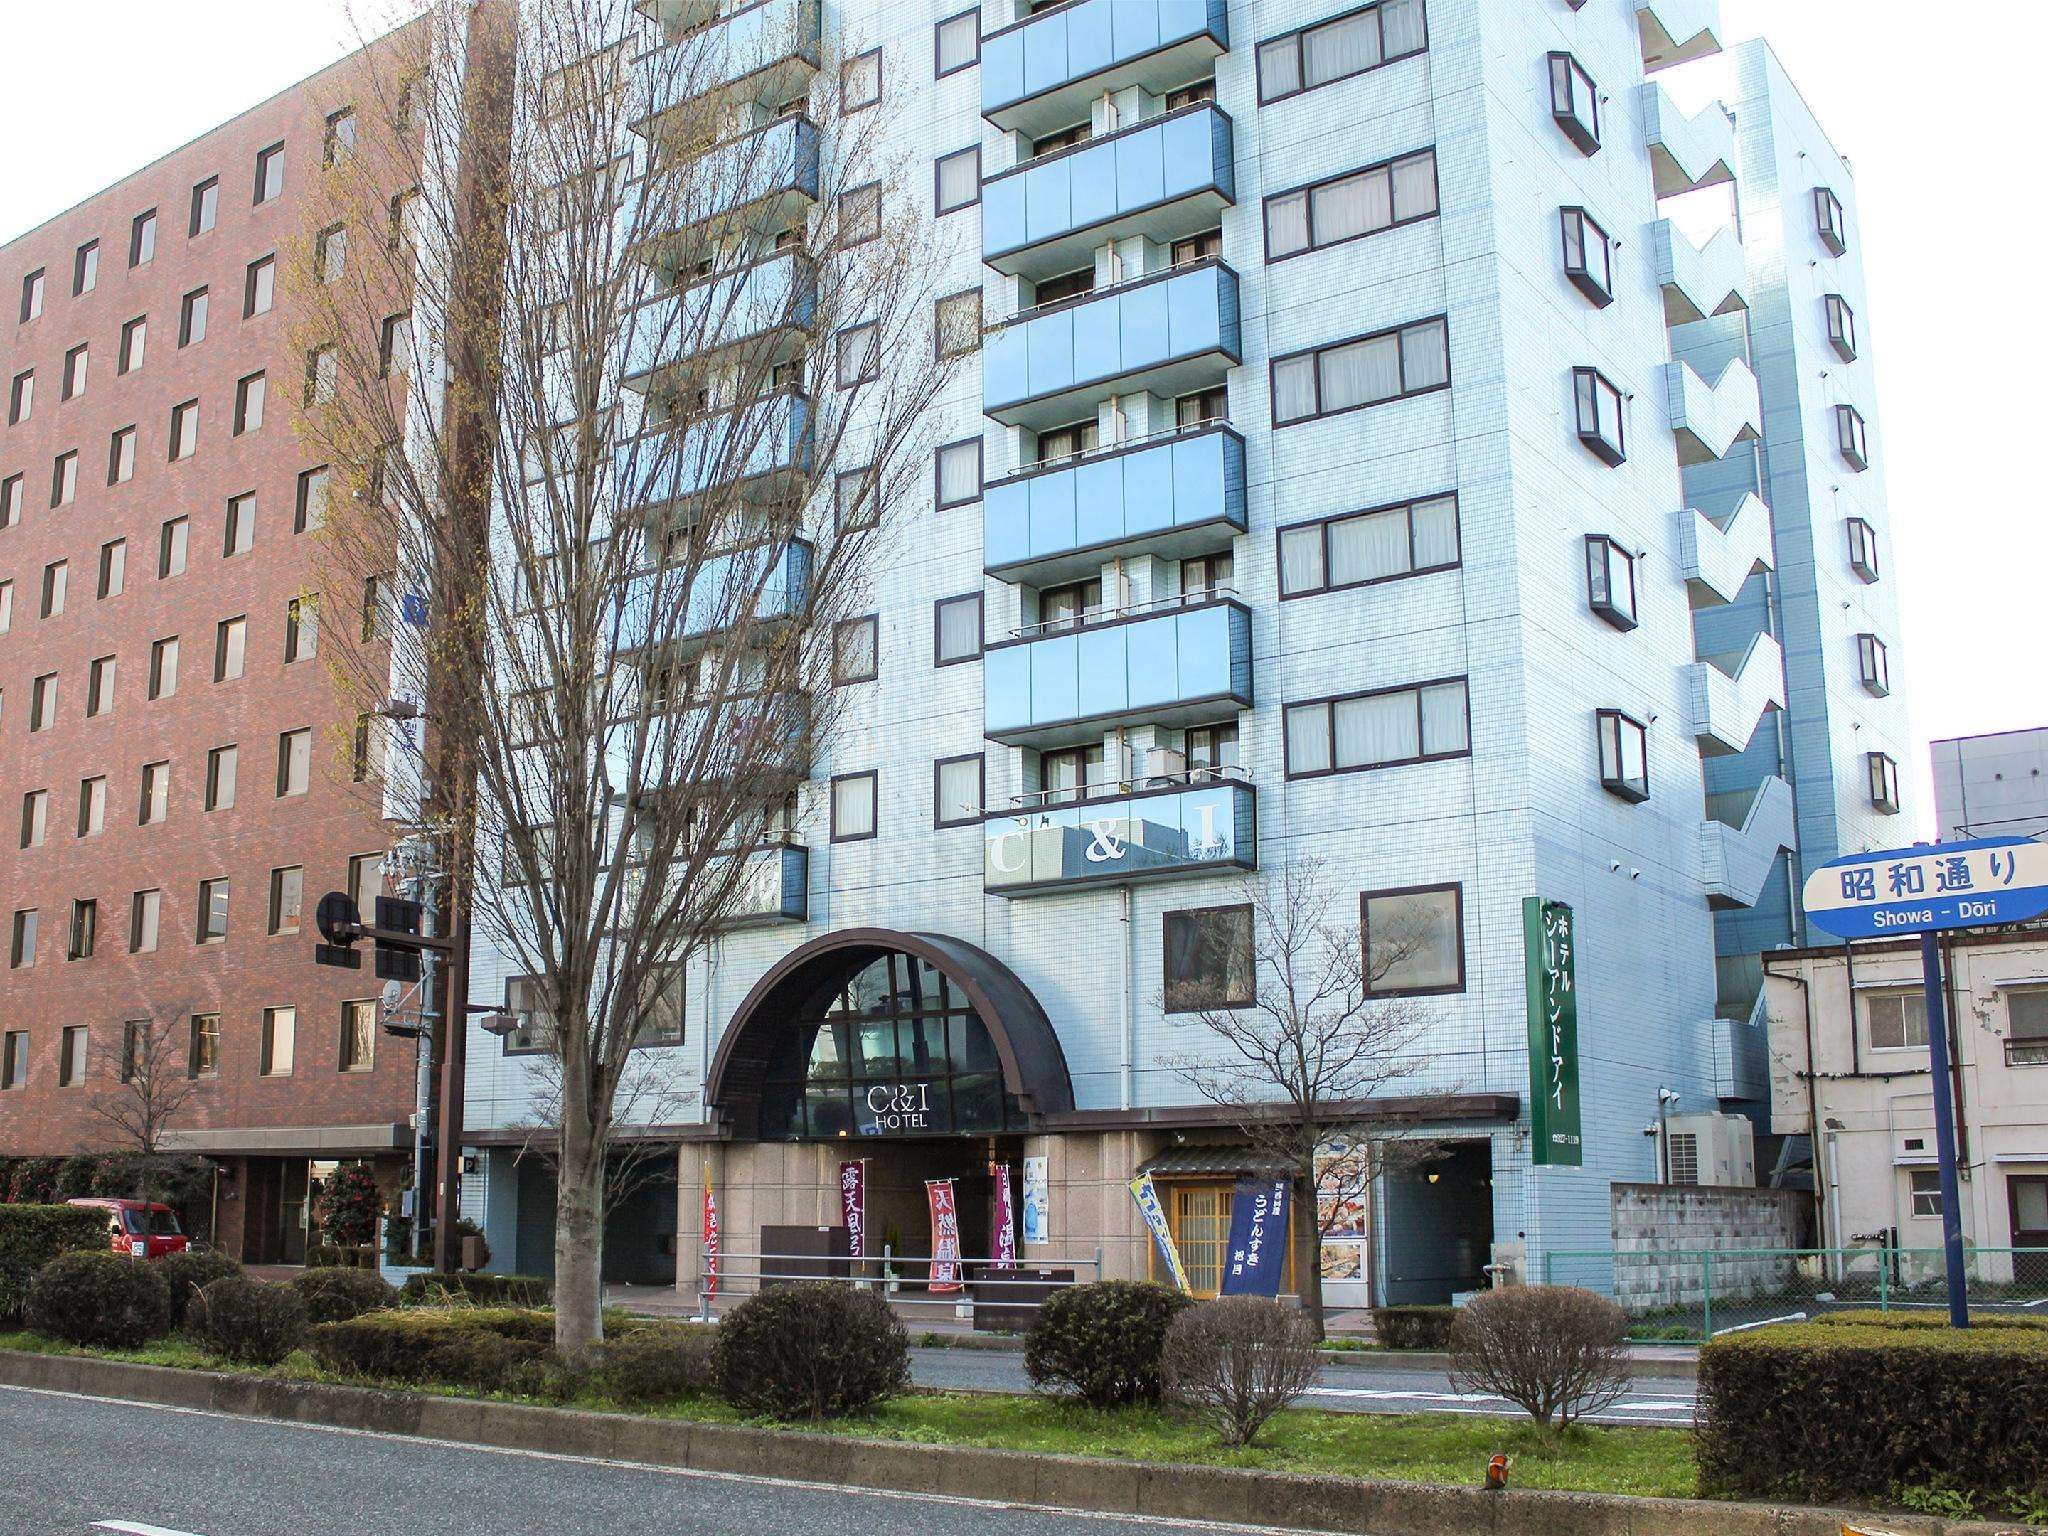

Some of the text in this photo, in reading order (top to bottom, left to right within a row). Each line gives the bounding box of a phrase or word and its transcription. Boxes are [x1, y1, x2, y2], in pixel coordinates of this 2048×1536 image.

[1085, 818, 1126, 863] &
[1839, 850, 2016, 902] 昭和通り
[1873, 909, 1933, 928] Showa
[1959, 899, 1997, 919] Dōri
[1557, 914, 1571, 993] ホテル
[1546, 910, 1564, 1111] シーアンドアイ
[867, 1083, 930, 1113] C&I
[875, 1113, 928, 1129] HOTEL
